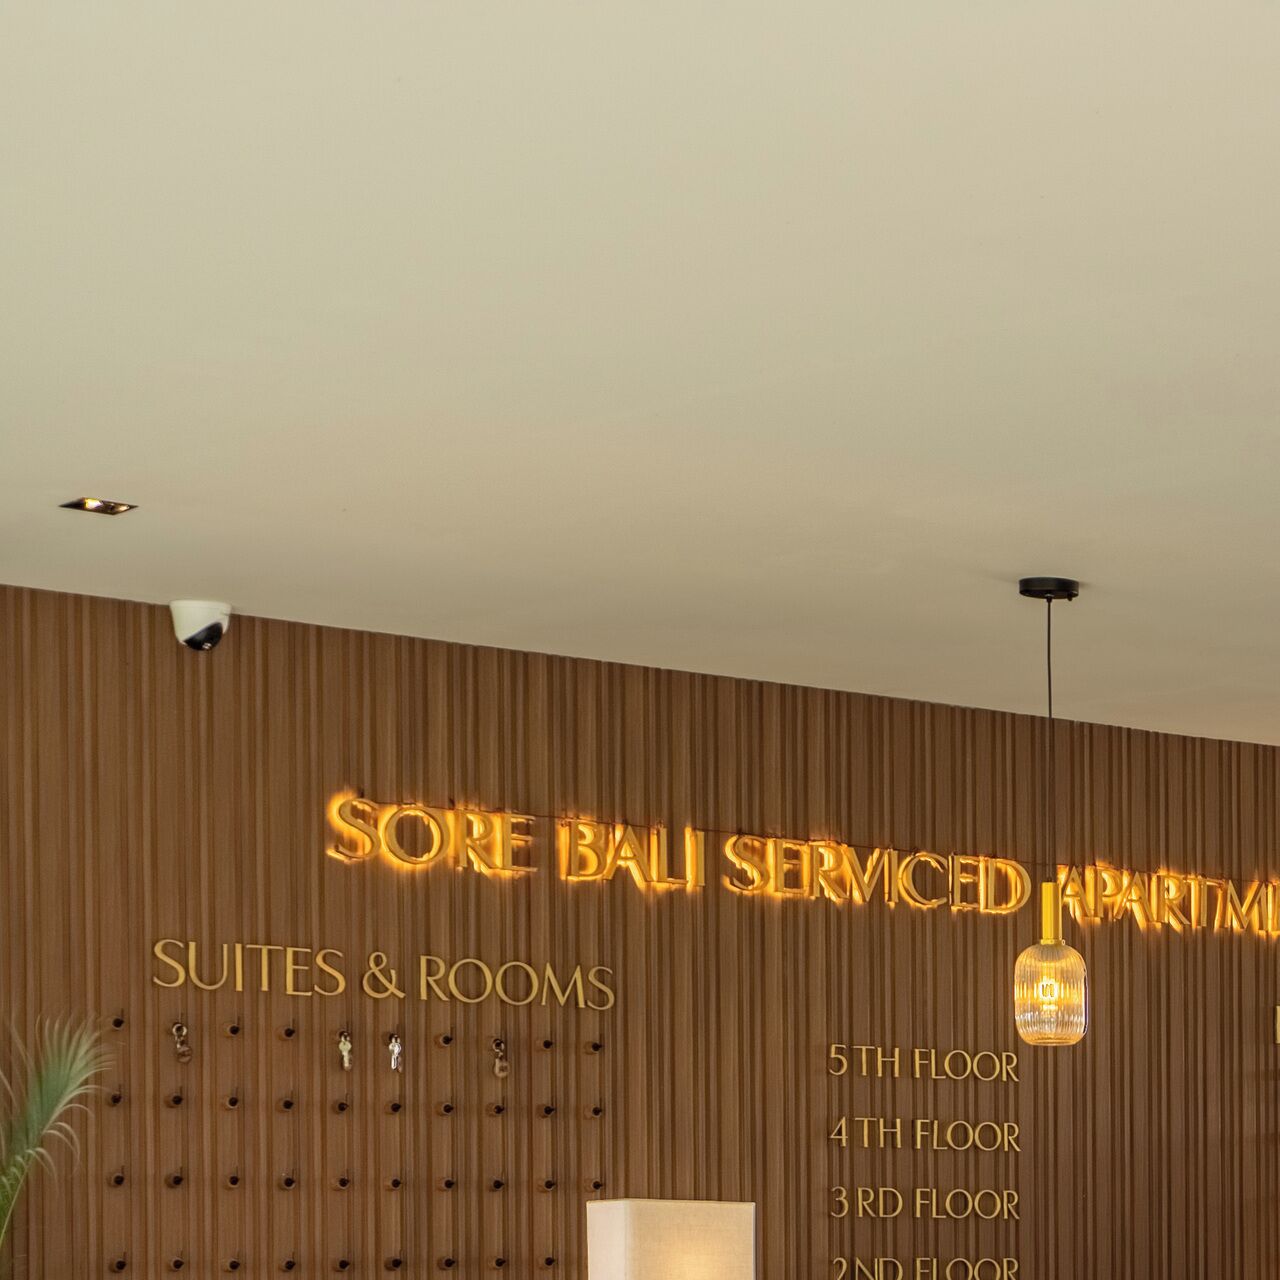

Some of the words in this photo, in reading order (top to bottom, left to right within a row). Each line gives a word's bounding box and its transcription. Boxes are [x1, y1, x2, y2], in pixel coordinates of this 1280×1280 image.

[328, 797, 538, 874] SORE
[559, 818, 706, 888] BALI
[723, 834, 1032, 914] SERVICED
[152, 938, 347, 997] SUITES
[362, 951, 406, 999] &
[419, 955, 616, 1011] ROOMS
[828, 1044, 900, 1078] 5TH
[912, 1048, 1020, 1082] FLOOR
[829, 1116, 902, 1149] 4TH
[914, 1119, 1022, 1152] FLOOR
[829, 1186, 904, 1218] 3RD
[914, 1188, 1021, 1220] FLOOR
